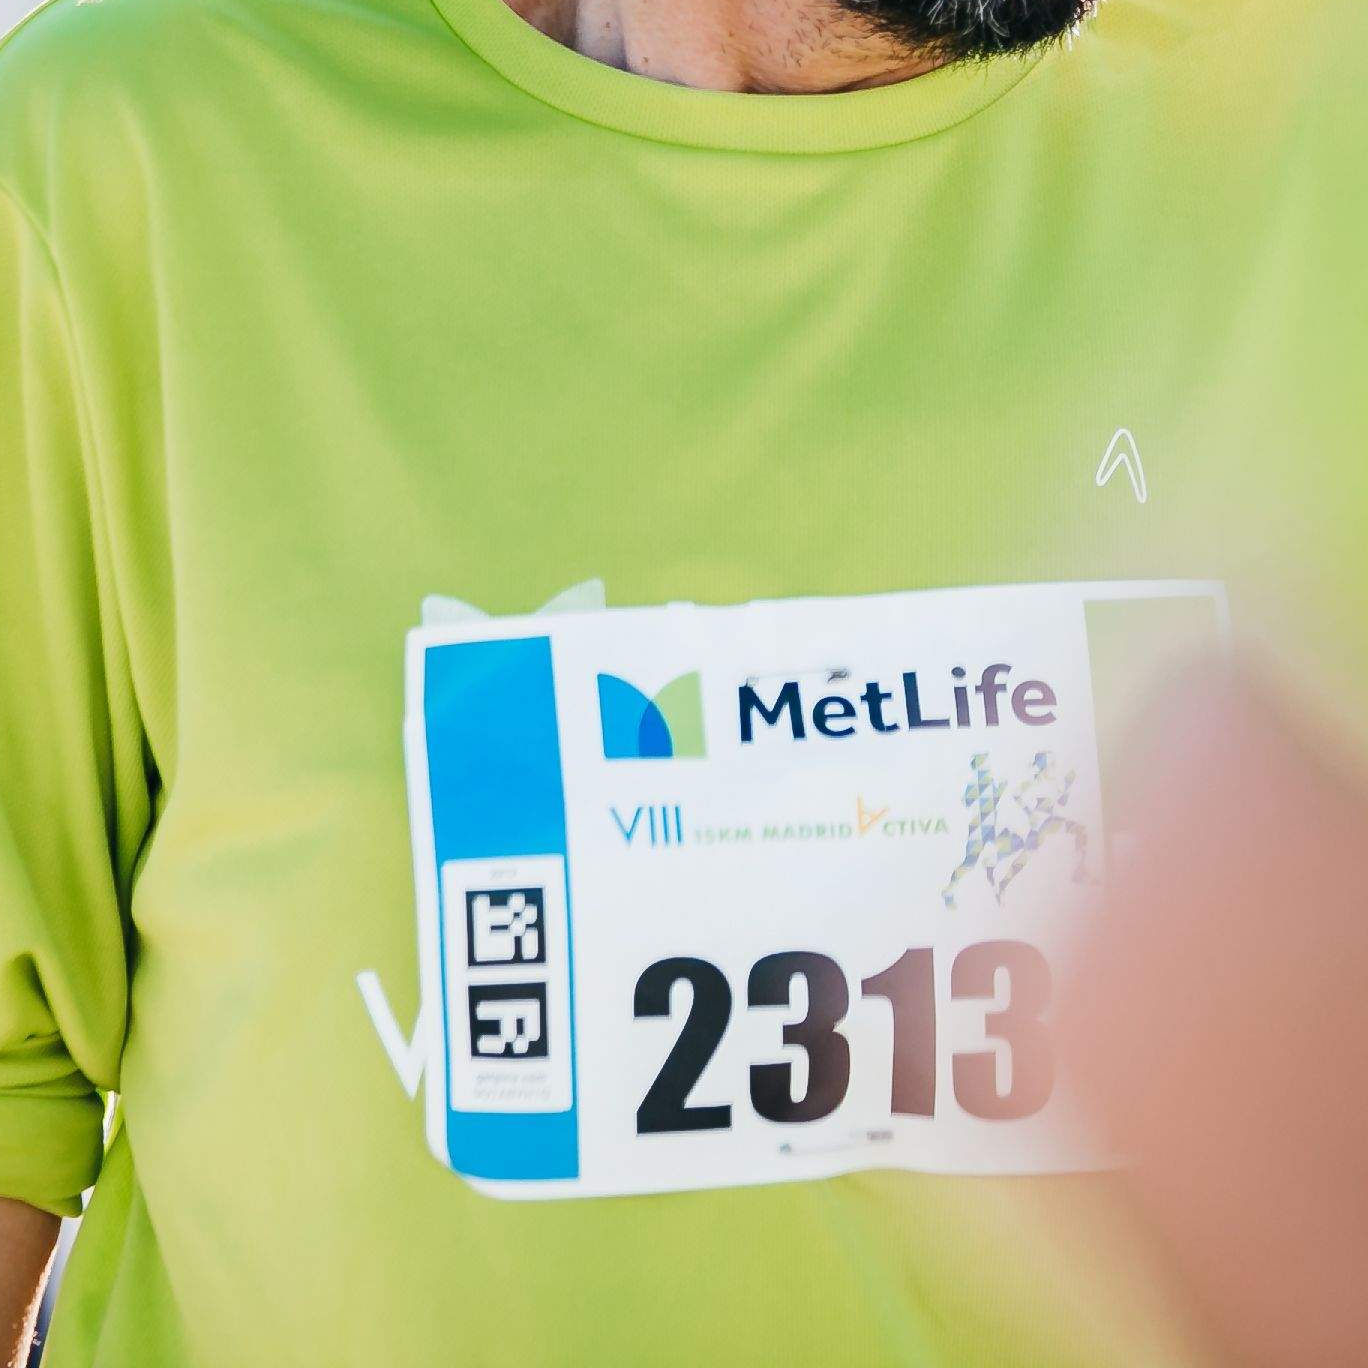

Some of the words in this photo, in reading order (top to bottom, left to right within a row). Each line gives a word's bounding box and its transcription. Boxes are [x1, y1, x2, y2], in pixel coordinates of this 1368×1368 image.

[737, 662, 1059, 744] MetLife
[609, 802, 683, 847] VIII
[762, 822, 854, 841] MADRID
[633, 940, 1055, 1135] 2313
